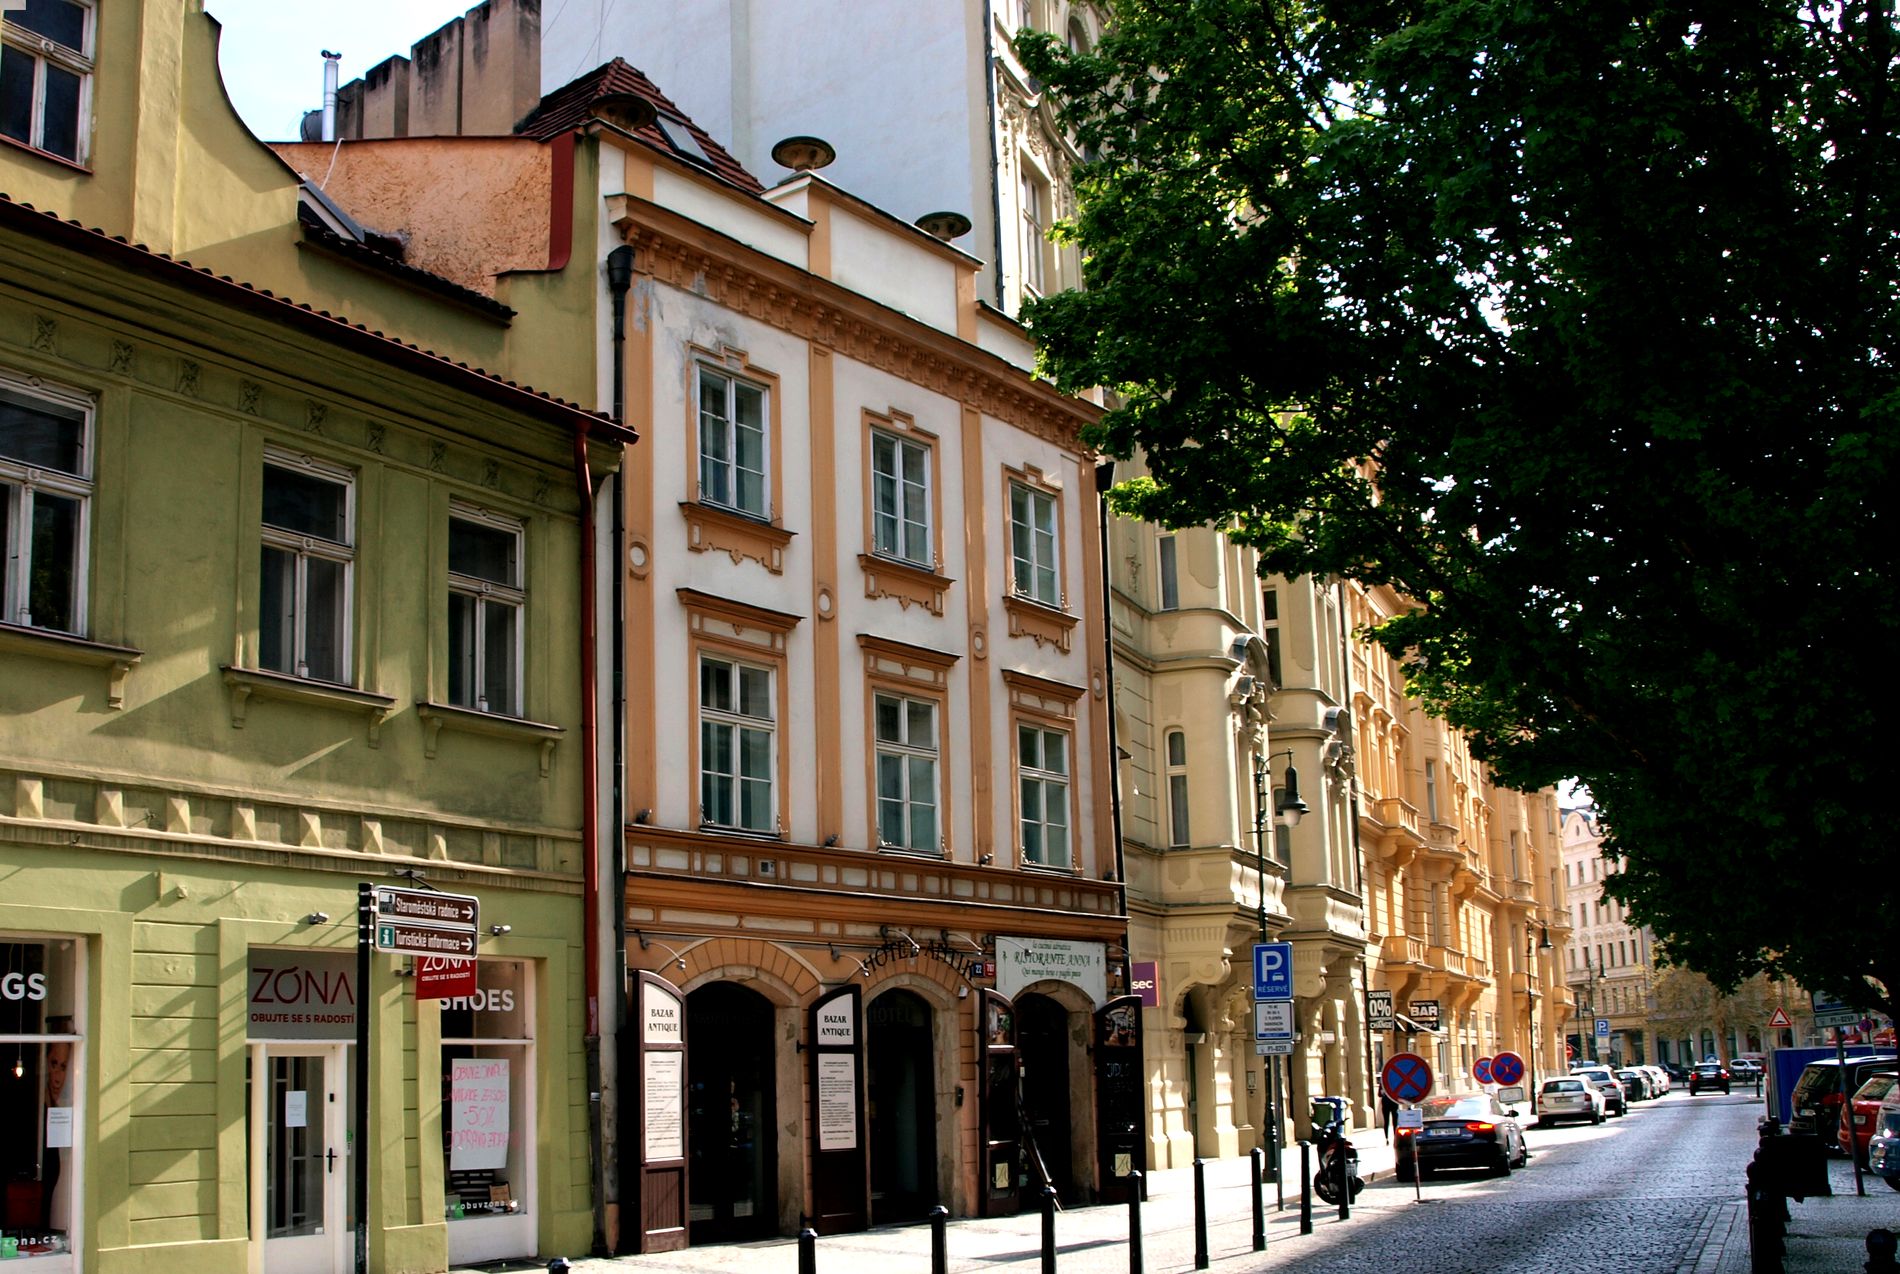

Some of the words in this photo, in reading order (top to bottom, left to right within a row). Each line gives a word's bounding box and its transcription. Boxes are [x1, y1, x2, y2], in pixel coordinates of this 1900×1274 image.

[396, 898, 436, 916] Staroměstská
[438, 903, 459, 918] radnice
[396, 930, 426, 947] Turistické
[428, 934, 460, 950] informace
[862, 940, 919, 972] HOTEL
[1014, 952, 1066, 966] RISTORANTE
[1066, 954, 1090, 967] ANNA
[976, 964, 982, 973] 22
[0, 972, 46, 1001] GS
[252, 966, 354, 1005] ZÓNA
[651, 1008, 674, 1018] BAZAR
[1410, 1006, 1438, 1016] BAR
[251, 1013, 288, 1023] OBUJTE
[291, 1014, 303, 1023] SE
[305, 1014, 311, 1023] S
[314, 1013, 354, 1024] RADOSTÍ
[824, 1015, 847, 1024] BAZAR
[648, 1022, 678, 1032] ANTIQUE
[821, 1028, 850, 1036] ANTIQUE
